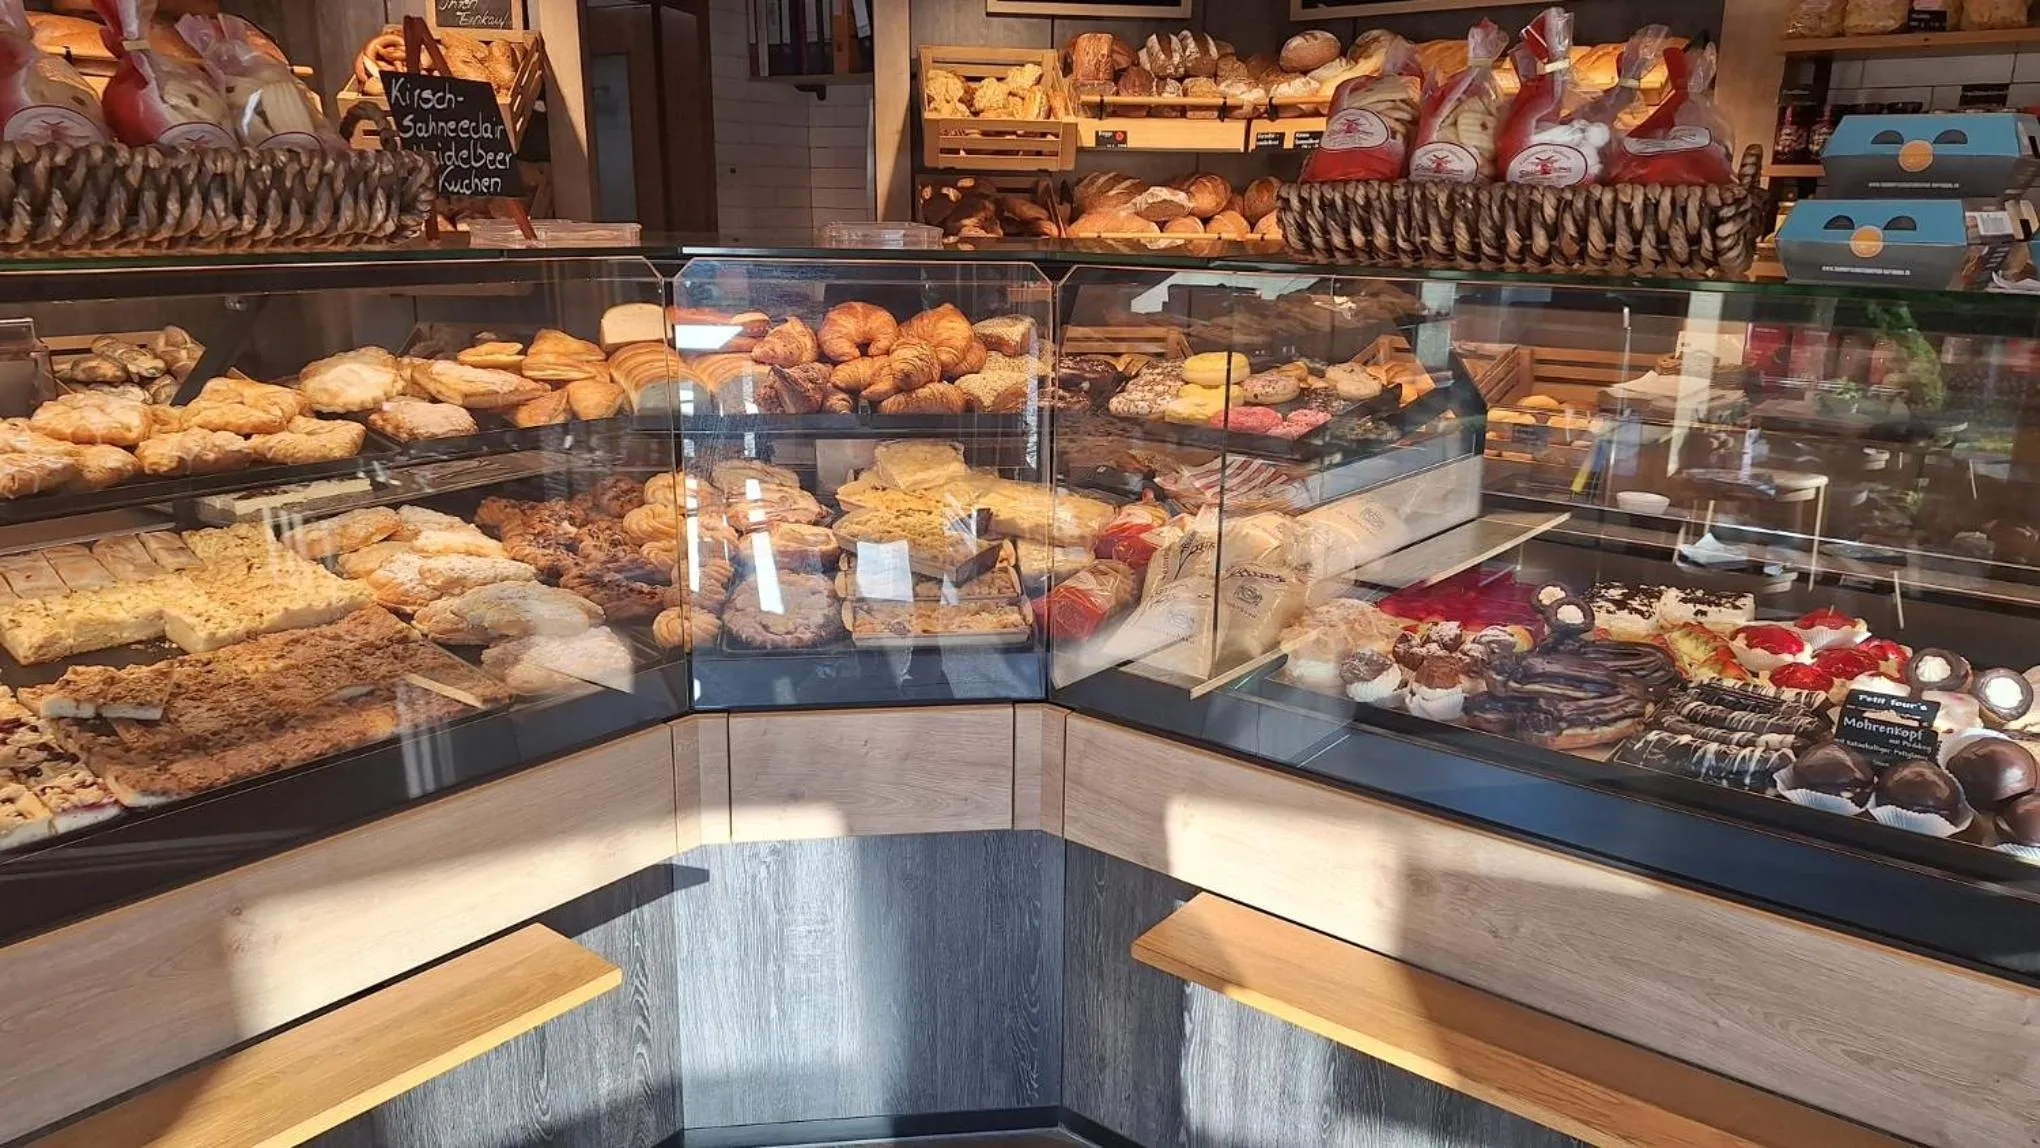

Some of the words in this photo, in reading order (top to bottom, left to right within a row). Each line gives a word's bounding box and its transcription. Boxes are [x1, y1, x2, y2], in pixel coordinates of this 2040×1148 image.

[390, 77, 465, 110] Kirsch-
[438, 165, 502, 194] Kuchen
[1858, 694, 1886, 704] Petit
